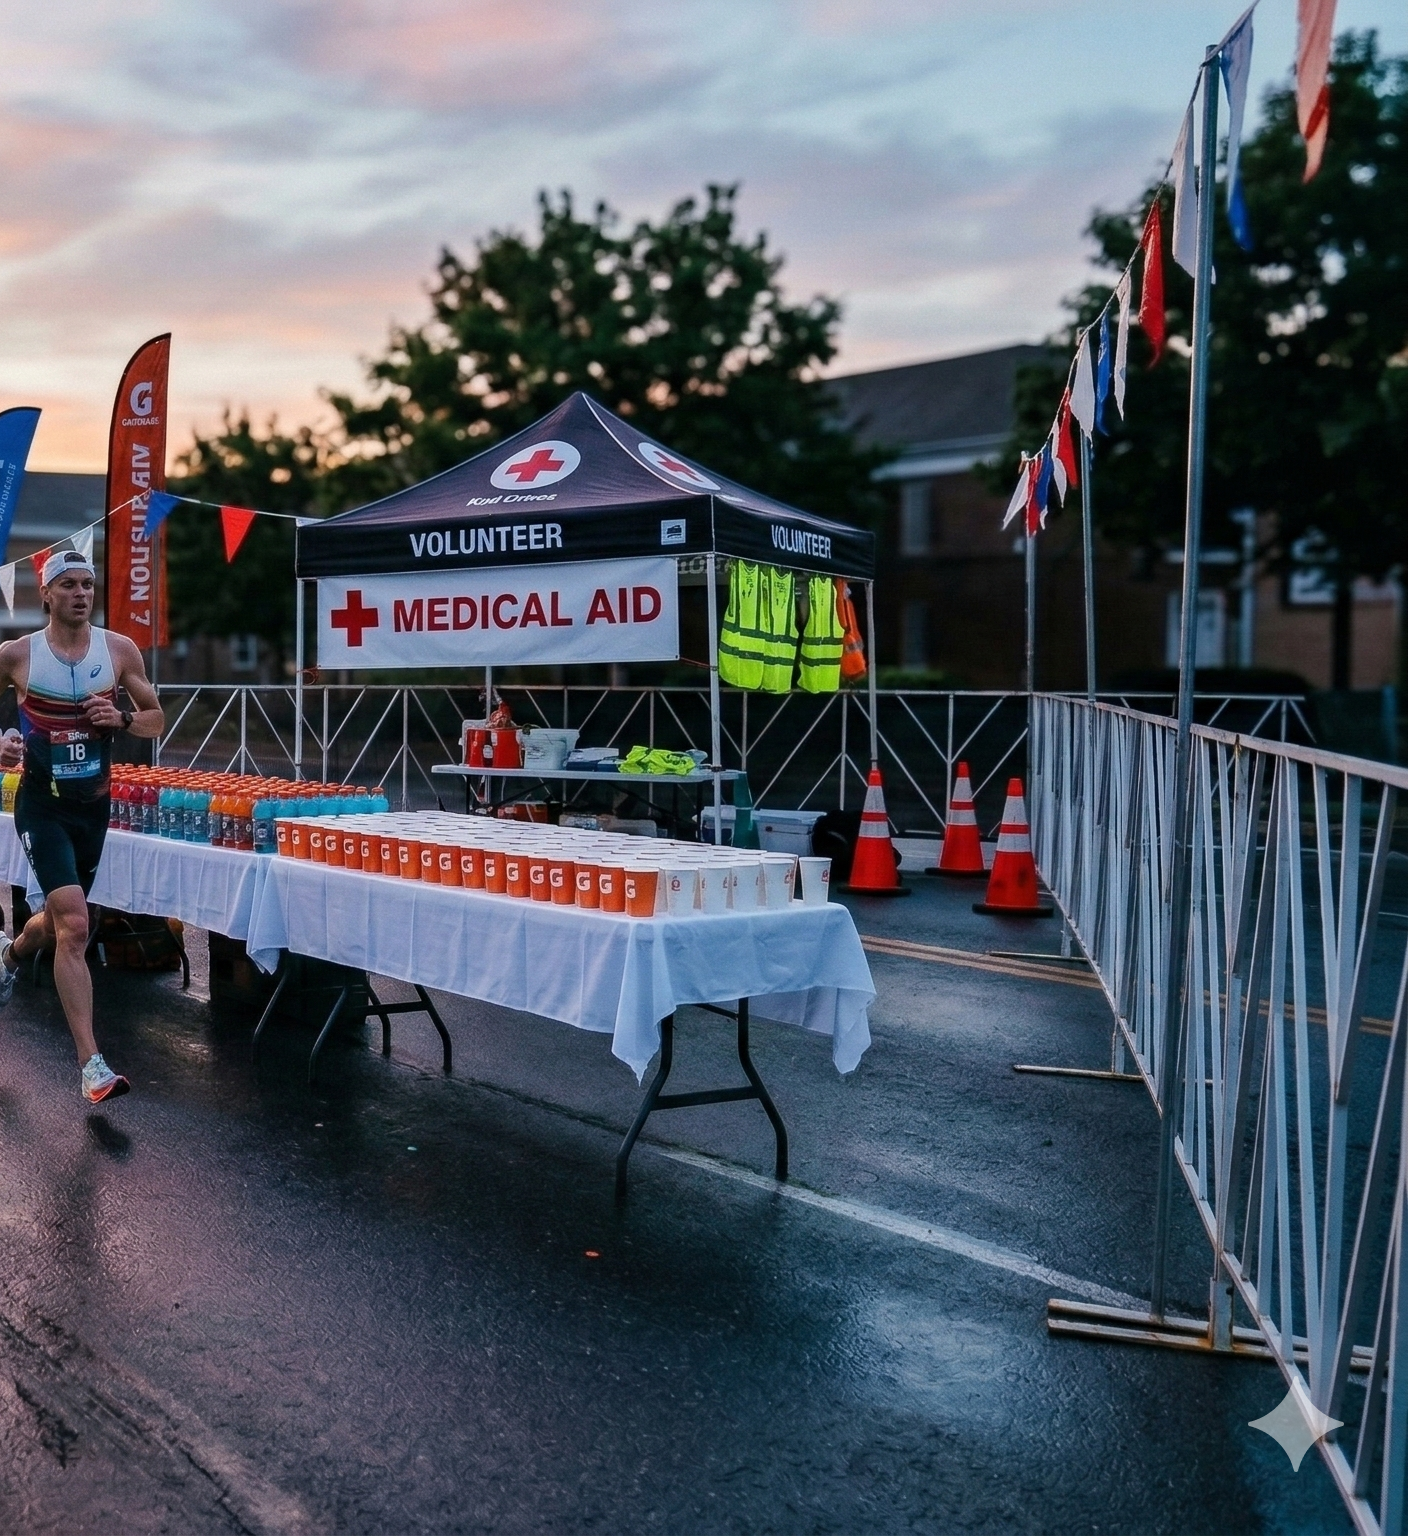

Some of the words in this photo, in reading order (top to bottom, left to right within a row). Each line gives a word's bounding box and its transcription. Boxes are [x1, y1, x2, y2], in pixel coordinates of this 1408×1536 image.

[130, 381, 153, 416] G
[410, 523, 563, 557] VOLUNTEER
[771, 524, 832, 559] VOLUNTEER
[393, 591, 573, 633] MEDICAL
[586, 586, 662, 626] AID
[66, 743, 86, 761] 18
[276, 826, 286, 842] G
[292, 829, 300, 845] G
[310, 832, 321, 848] G
[325, 835, 337, 851] G
[343, 838, 354, 854] G
[361, 841, 369, 857] G
[381, 843, 390, 860] G
[398, 846, 409, 863] G
[421, 850, 432, 867] G
[439, 853, 451, 870] G
[461, 855, 473, 873] G
[485, 858, 495, 877] G
[506, 862, 519, 881] G
[530, 865, 544, 884] G
[550, 868, 563, 887] G
[576, 871, 590, 891] G
[599, 874, 612, 894] G
[625, 879, 636, 899] G
